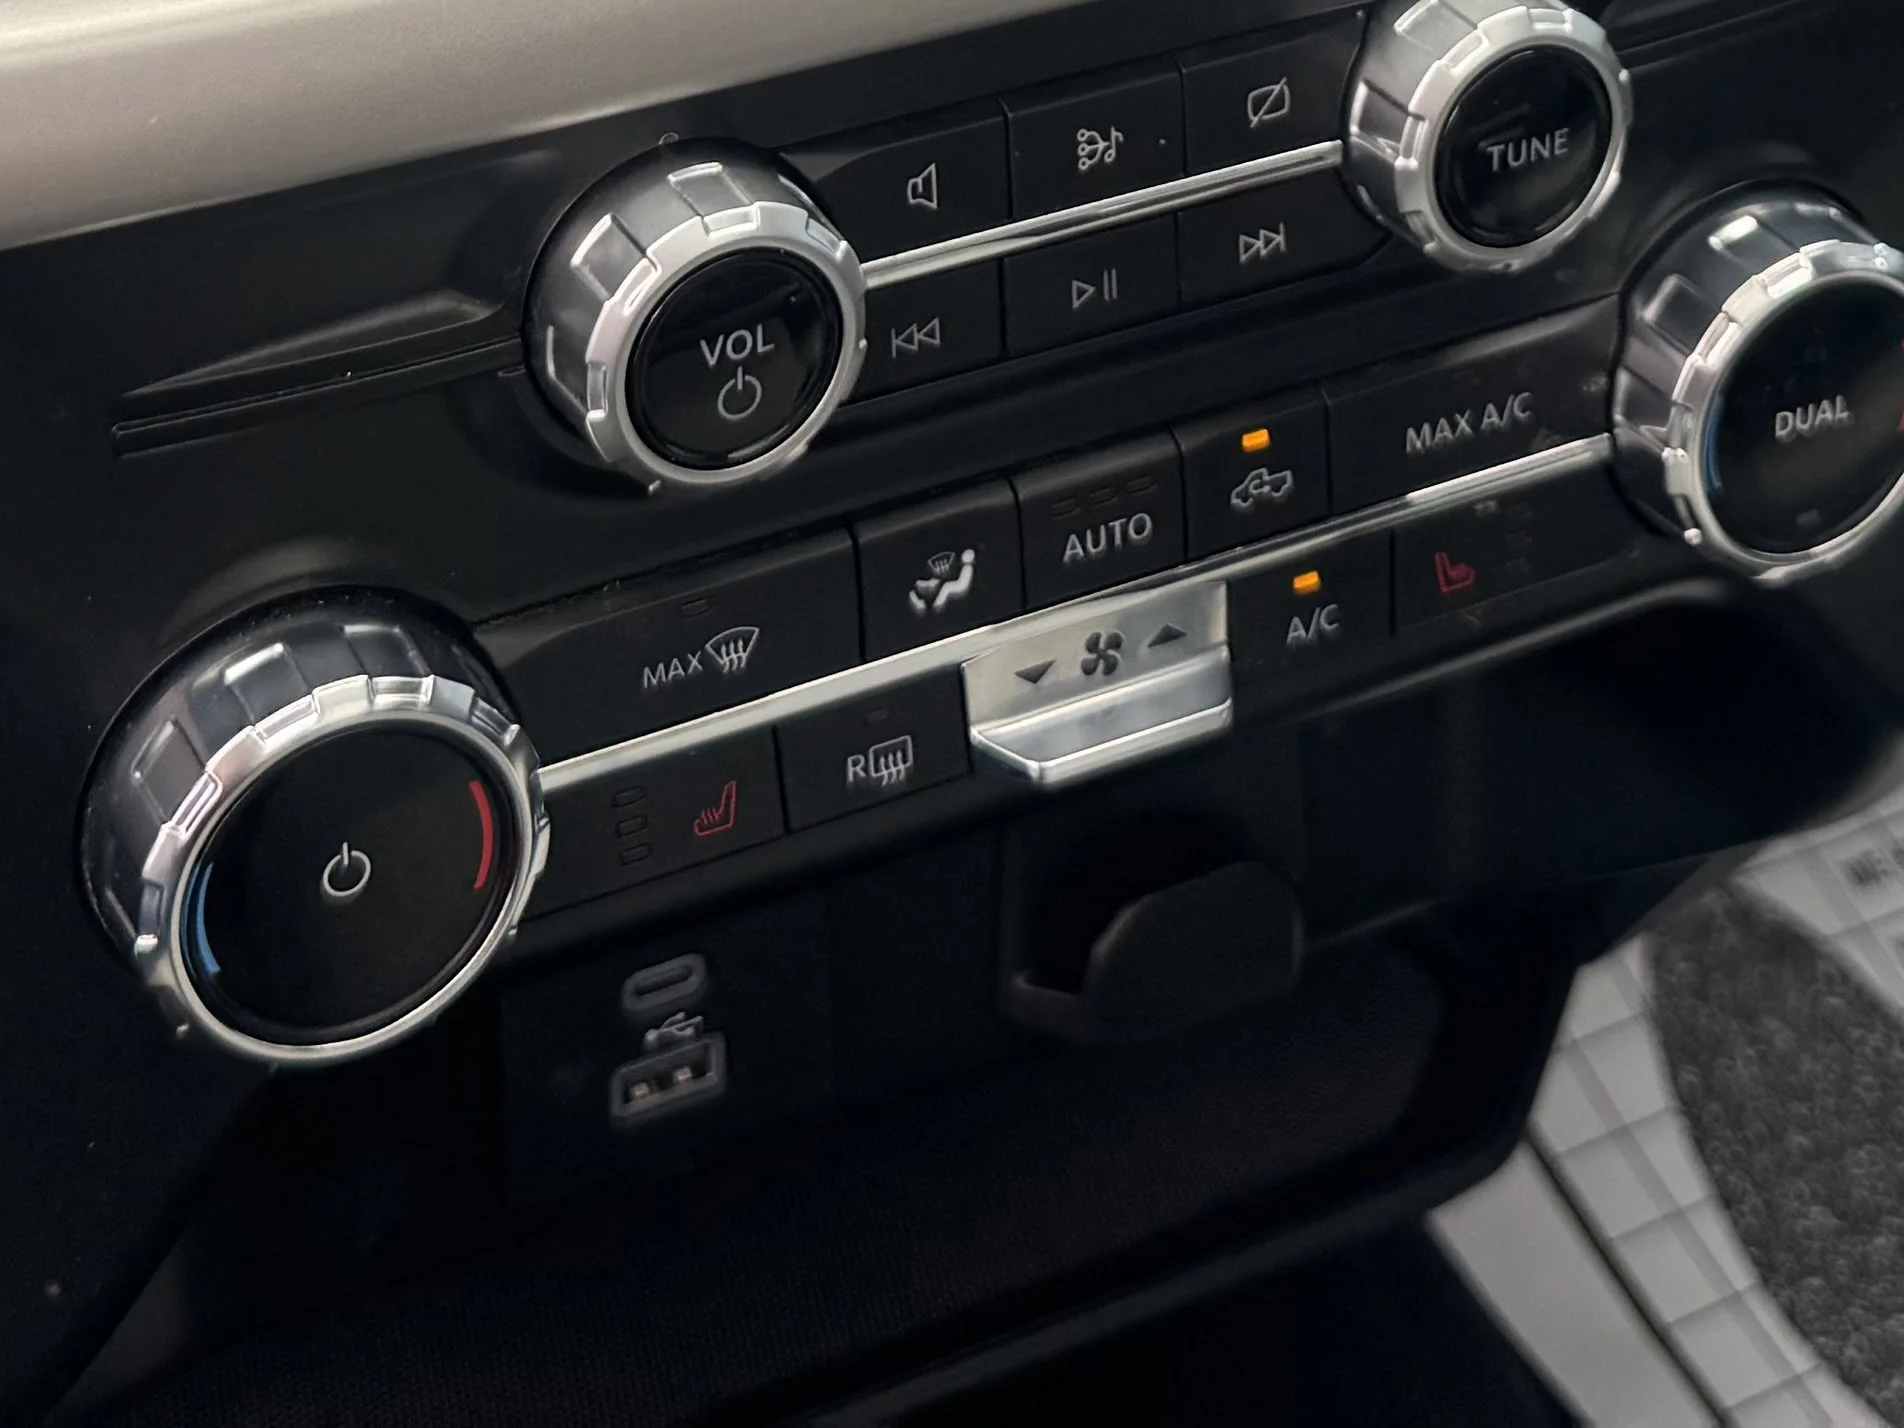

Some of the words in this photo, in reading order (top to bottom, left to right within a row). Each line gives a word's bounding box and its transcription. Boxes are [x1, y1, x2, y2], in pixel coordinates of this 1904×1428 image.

[1487, 129, 1571, 172] TUNE
[700, 324, 775, 367] VOL
[1406, 409, 1473, 454] MAX
[1480, 391, 1532, 431] A/C
[1775, 395, 1852, 442] DUAL
[1063, 512, 1153, 563] AUTO
[1286, 603, 1339, 645] A/C
[643, 650, 703, 689] MAX
